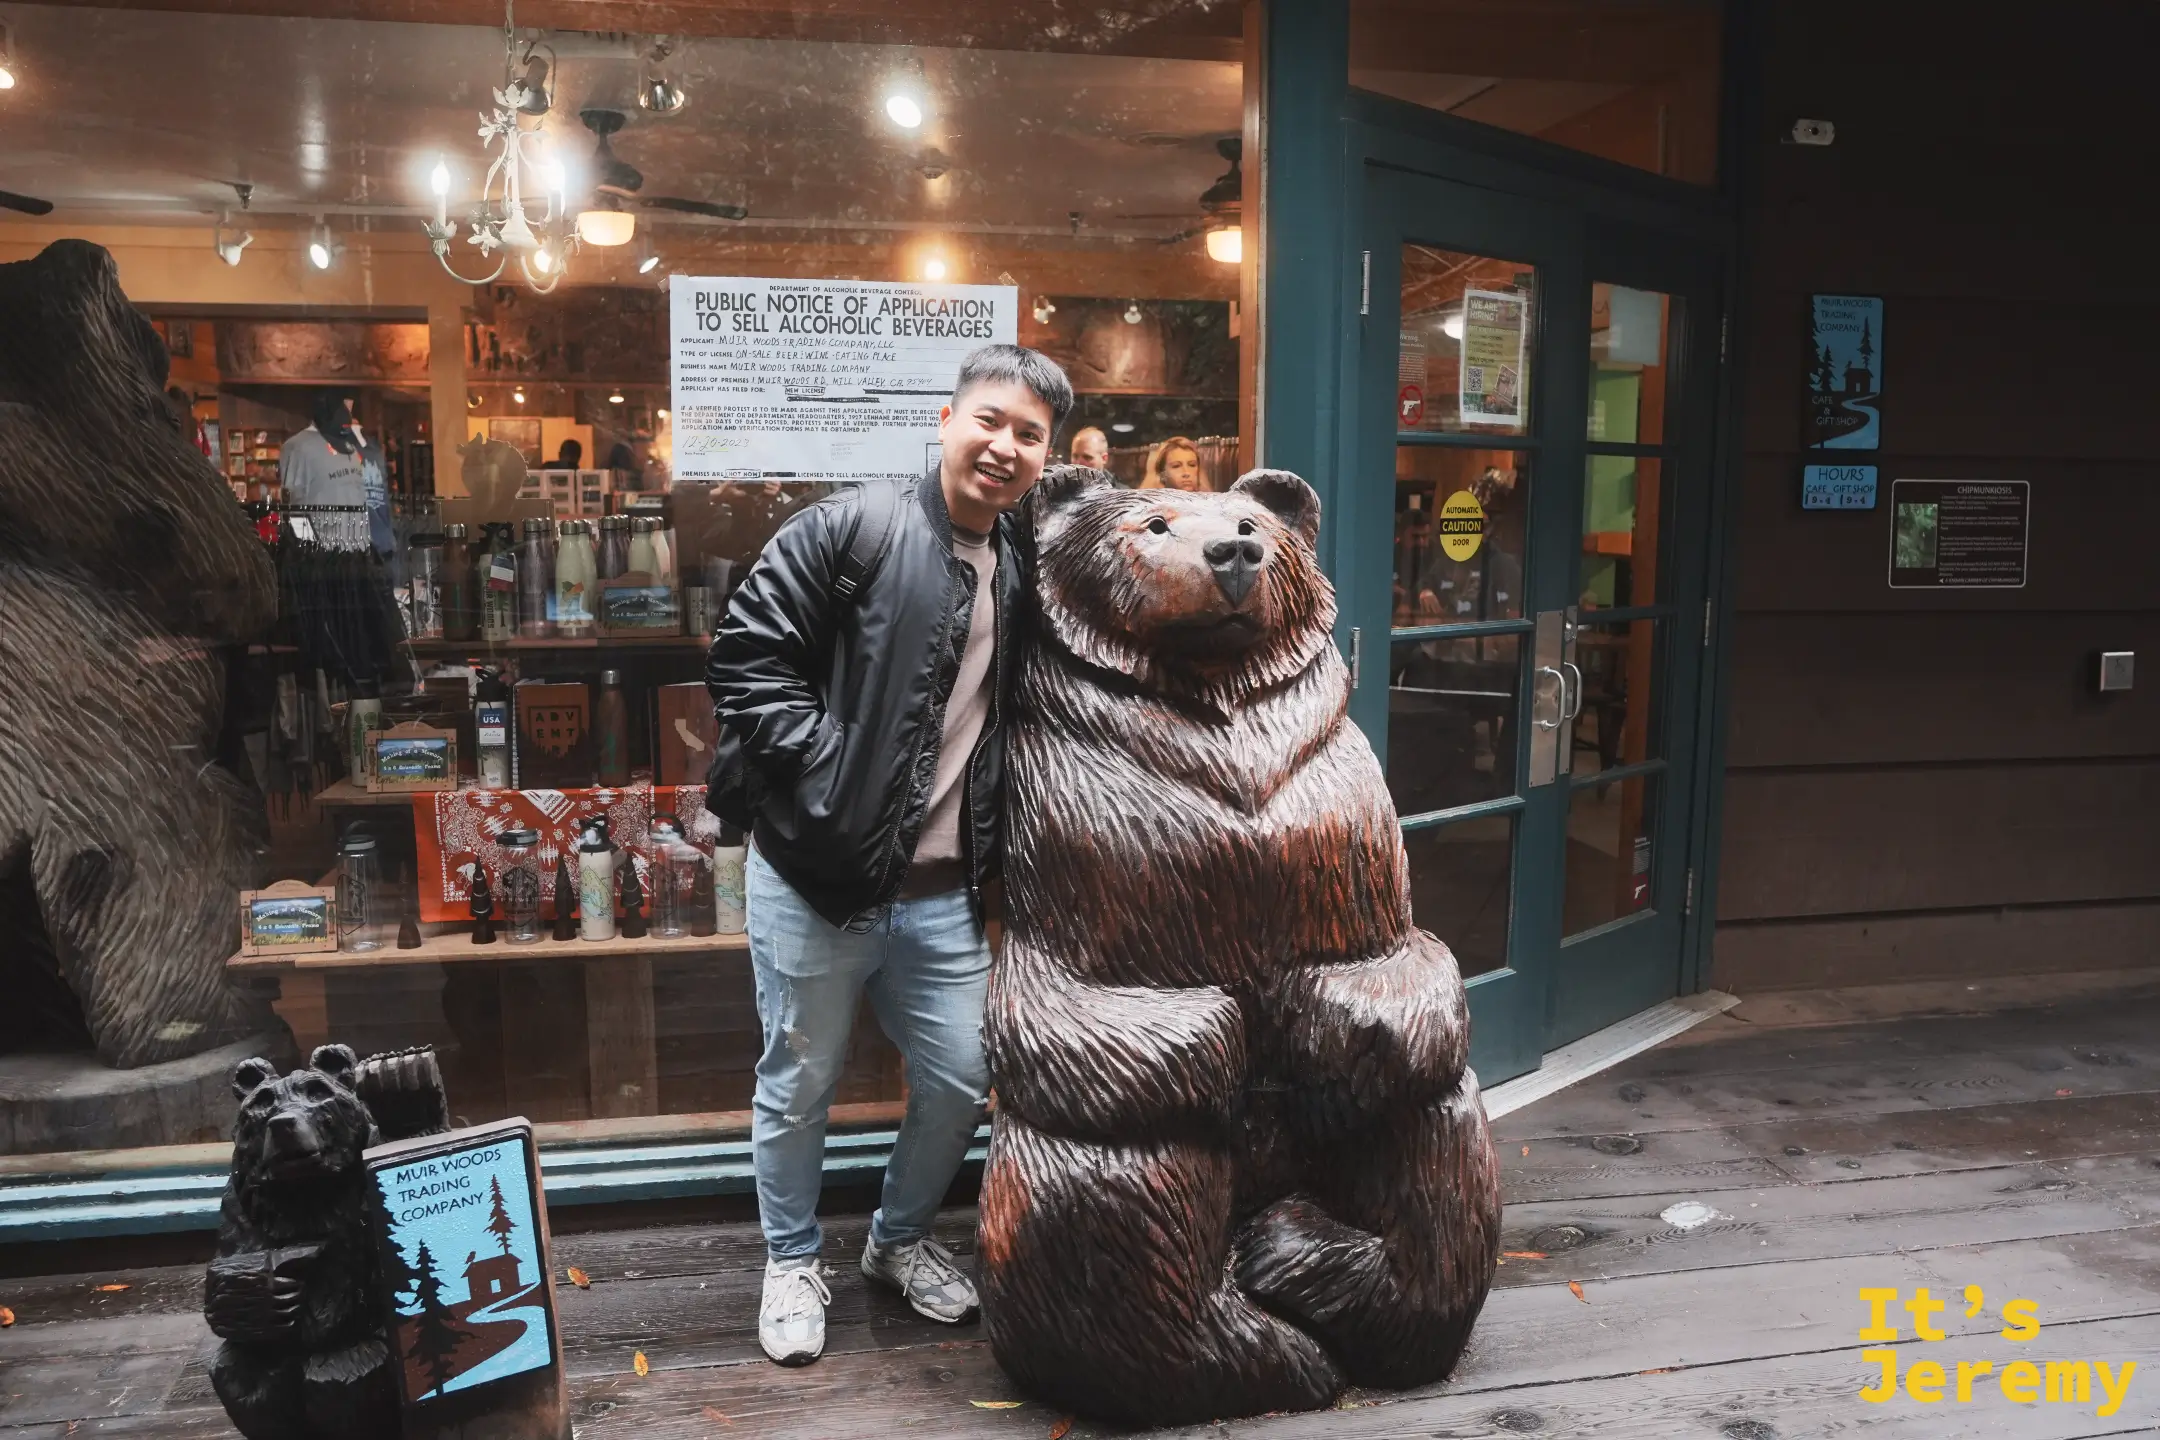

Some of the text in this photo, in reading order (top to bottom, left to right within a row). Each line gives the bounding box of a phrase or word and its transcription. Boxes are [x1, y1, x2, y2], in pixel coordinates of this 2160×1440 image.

[696, 292, 993, 318] PUBLIC NOTICE OF APPLICATION
[1470, 300, 1498, 311] WE ARE
[1821, 298, 1872, 308] MUIR WOODS
[1821, 310, 1856, 320] TRADING
[696, 312, 992, 338] TO SELL ALCOHOLIC BEVERAGES
[1820, 324, 1860, 332] COMPANY
[720, 335, 748, 345] MUIR
[753, 337, 780, 345] WOODS
[782, 337, 827, 348] TRADING
[736, 349, 771, 359] ON-SALE
[776, 350, 798, 359] BEER
[805, 351, 829, 360] WINE
[872, 352, 896, 361] PLACE
[730, 362, 756, 370] MUIR
[790, 364, 827, 372] TRADING
[830, 364, 870, 373] COMPANY
[757, 376, 780, 384] MUIR
[784, 377, 810, 385] WOODS
[1812, 396, 1833, 405] CAFE
[1816, 417, 1858, 426] GIFT SHOP
[328, 468, 349, 480] MUIR
[1818, 468, 1864, 481] HOURS
[1806, 485, 1874, 494] CAFE GIFT SHOP
[1442, 521, 1480, 532] CAUTION
[381, 751, 402, 763] Making
[421, 749, 443, 762] Memory
[544, 795, 561, 811] WOODS
[550, 799, 569, 819] National
[256, 910, 279, 922] Making
[299, 907, 321, 920] Memory
[396, 1149, 501, 1184] MUIR WOODS
[398, 1176, 470, 1202] TRADING
[402, 1192, 483, 1222] COMPANY
